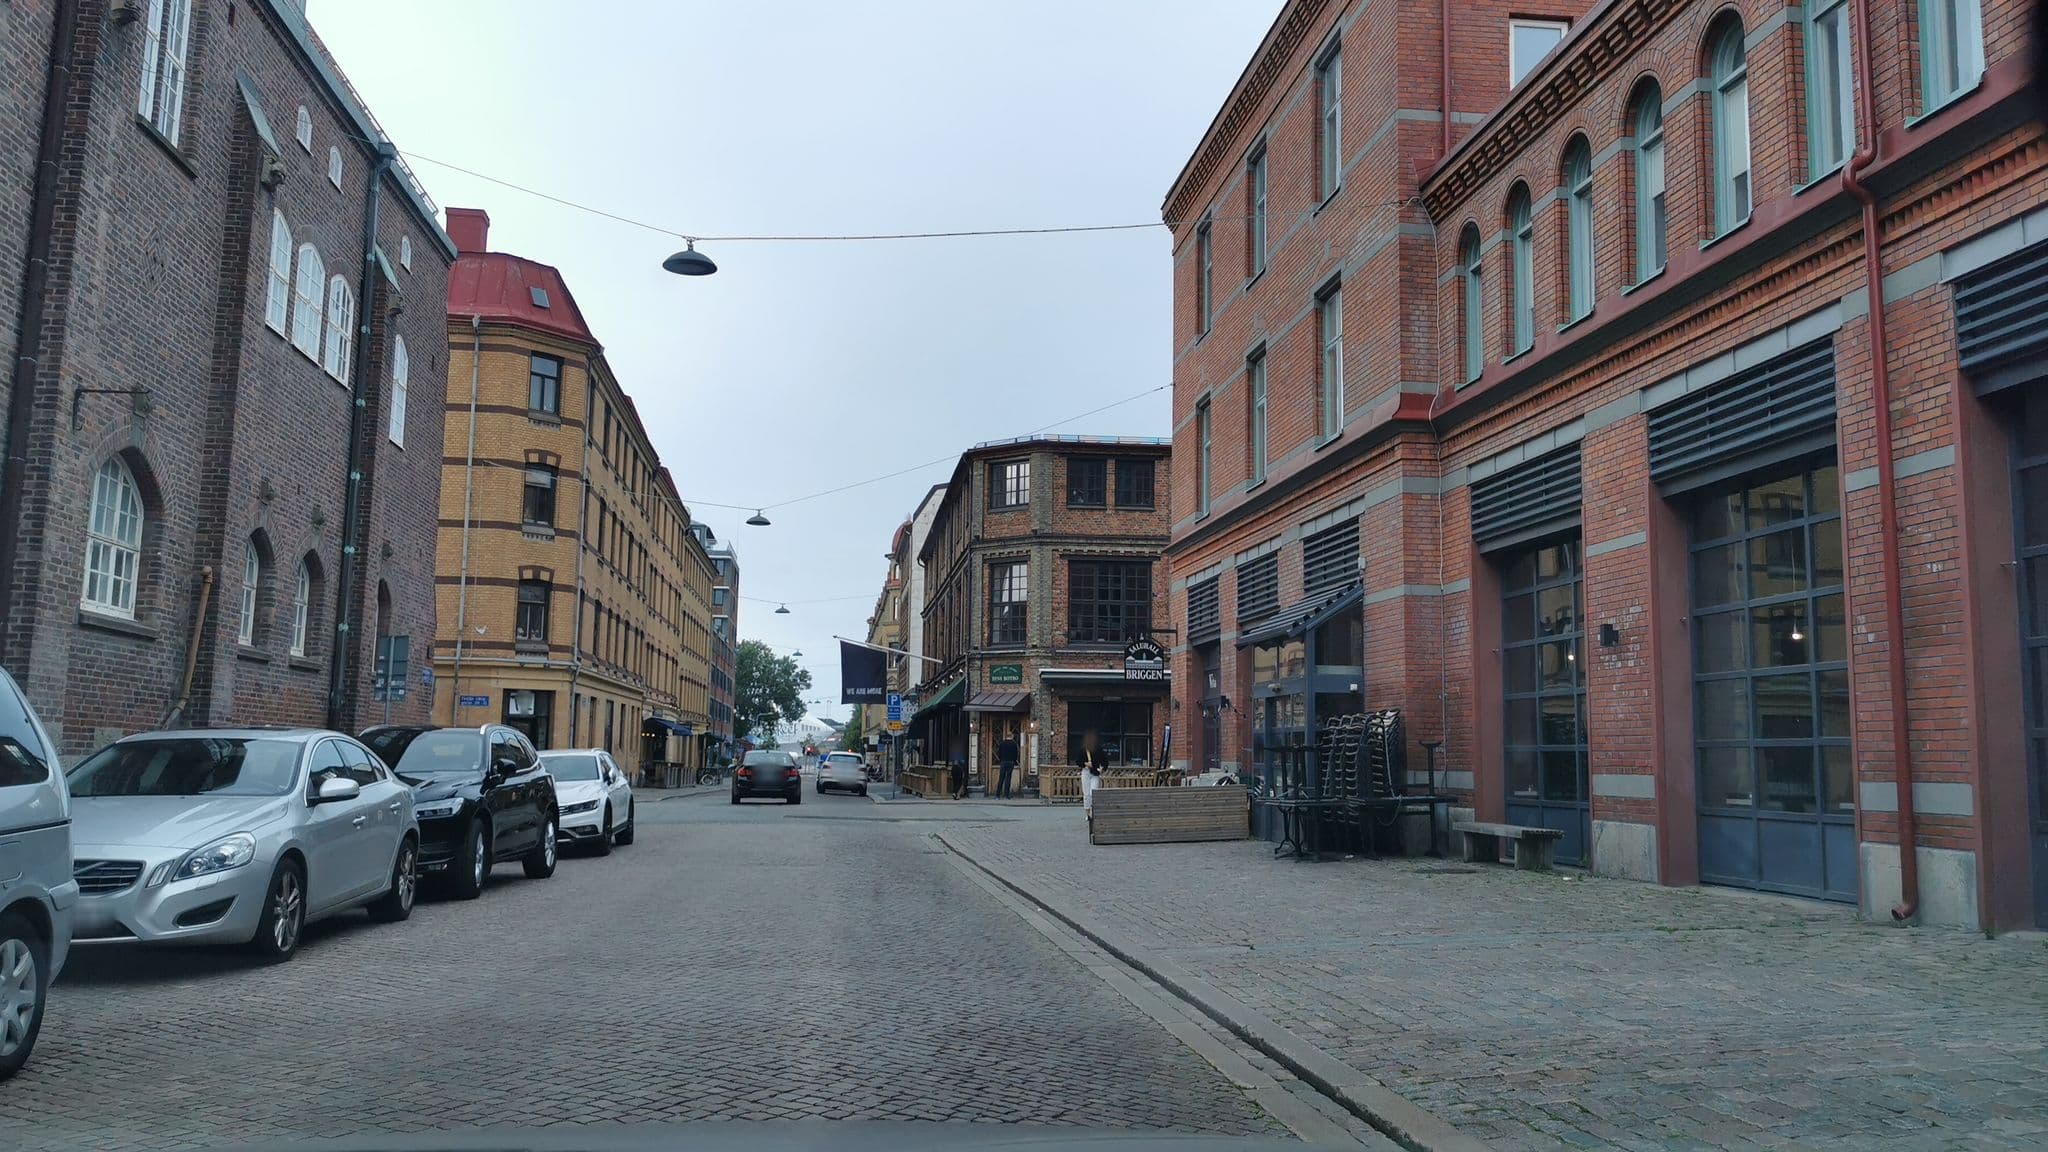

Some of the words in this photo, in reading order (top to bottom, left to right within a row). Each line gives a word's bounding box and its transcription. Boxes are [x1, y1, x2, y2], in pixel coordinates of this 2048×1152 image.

[1128, 642, 1160, 655] SALUHALL
[1126, 669, 1162, 680] BRIGGEN
[846, 687, 855, 695] WE
[855, 687, 866, 695] ARE
[866, 687, 882, 695] MORE
[891, 695, 898, 705] P
